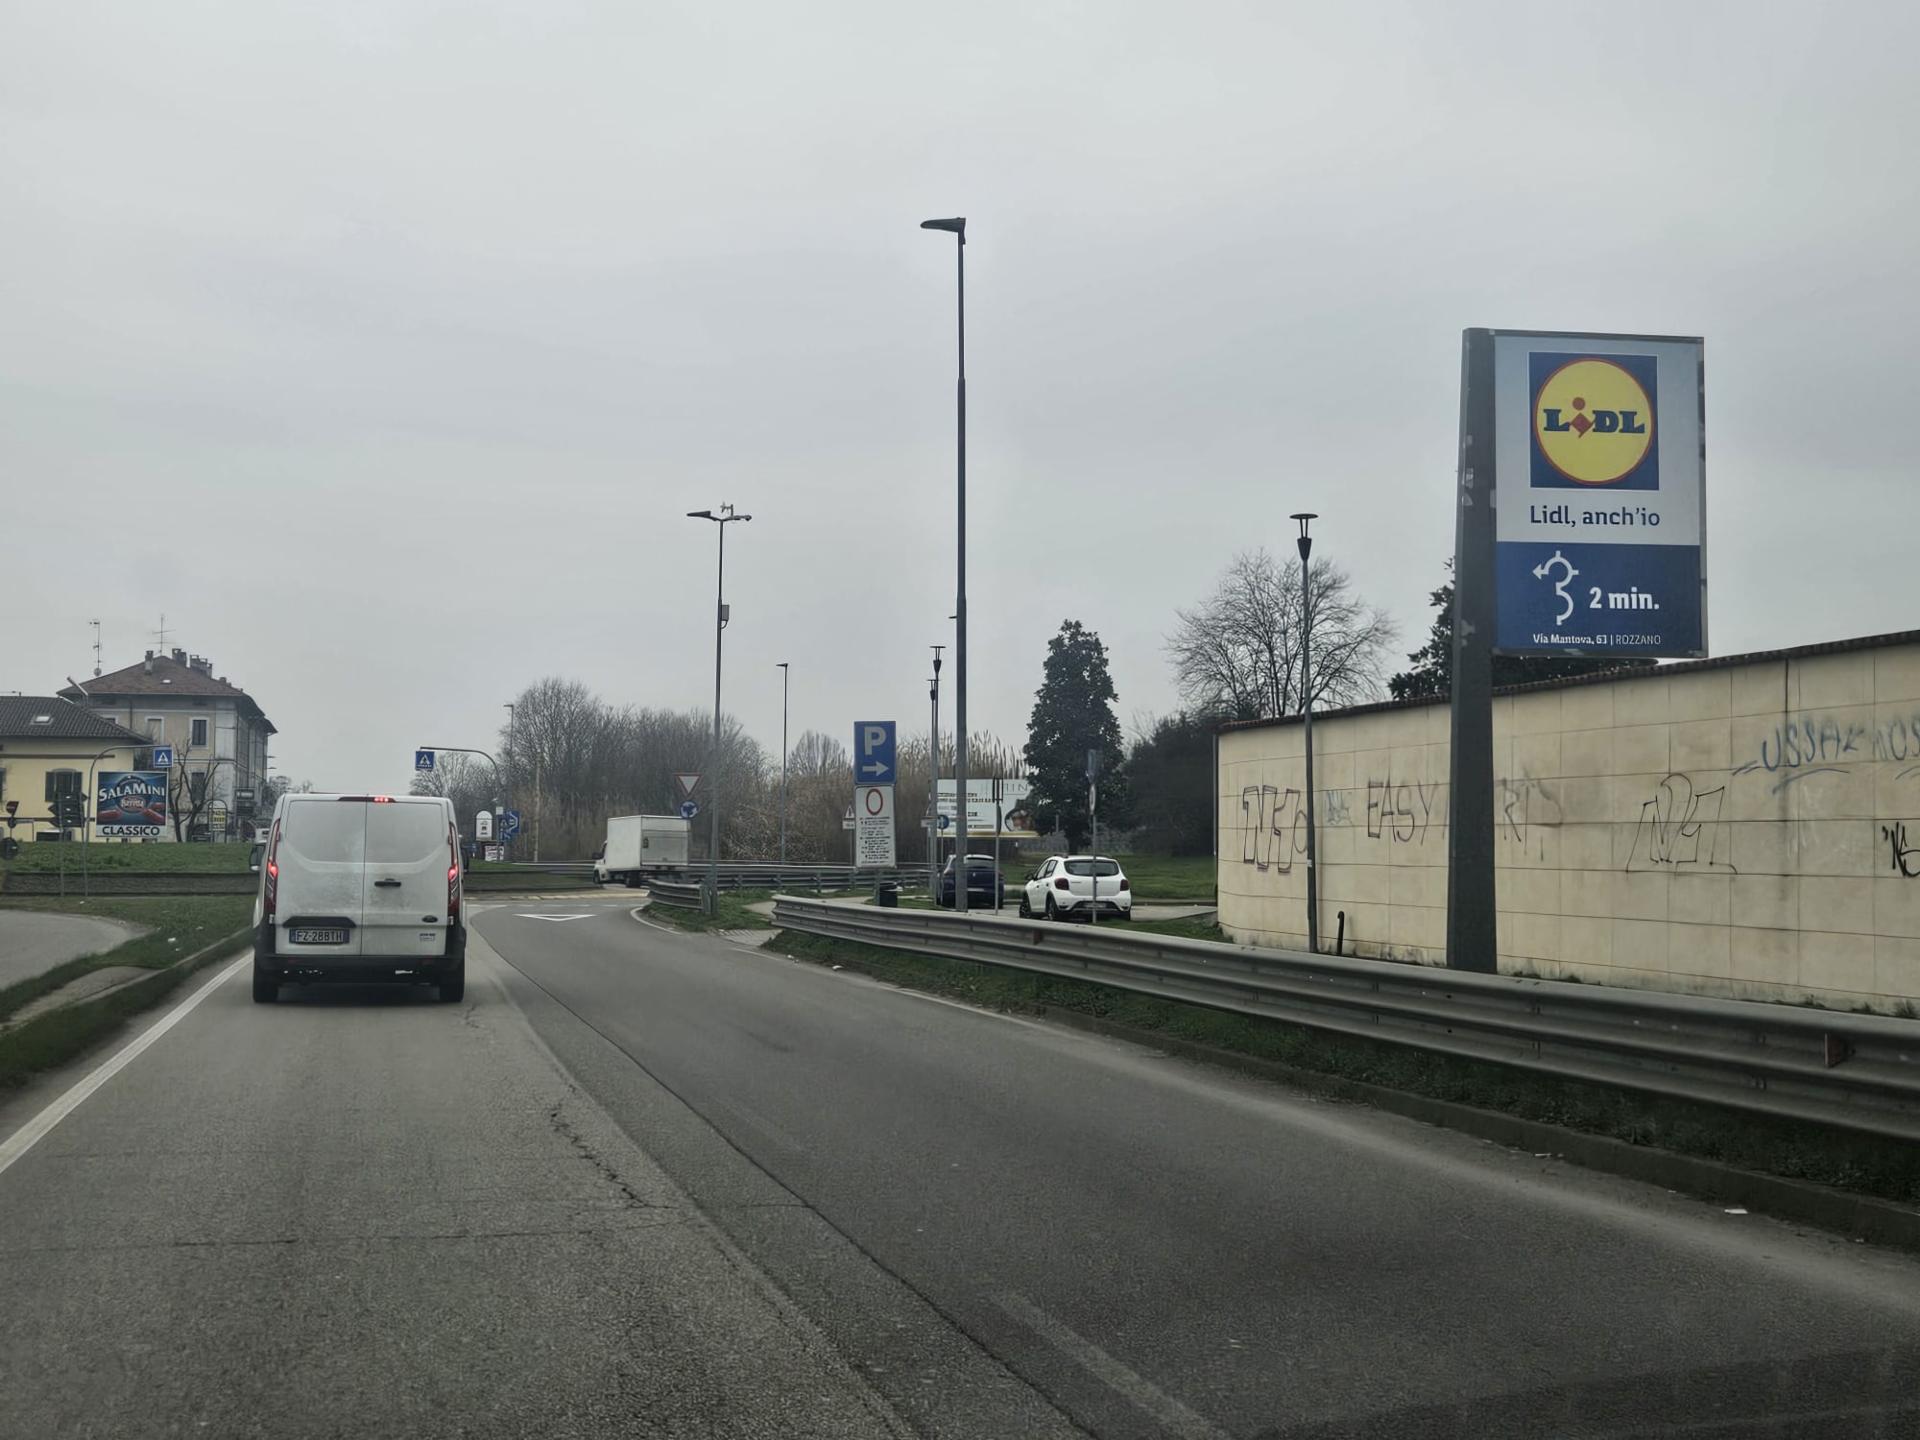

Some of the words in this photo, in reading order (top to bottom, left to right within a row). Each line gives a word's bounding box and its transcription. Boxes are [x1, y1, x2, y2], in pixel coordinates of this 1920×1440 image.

[1530, 505, 1576, 527] Lidl,
[1582, 506, 1660, 526] anch'io
[1589, 586, 1602, 609] 2
[1608, 586, 1660, 610] min.
[1533, 633, 1549, 644] Via
[1550, 633, 1595, 645] Mantova,
[1615, 634, 1661, 645] ROZZANO
[864, 726, 886, 755] P
[102, 826, 160, 836] CLASSICO
